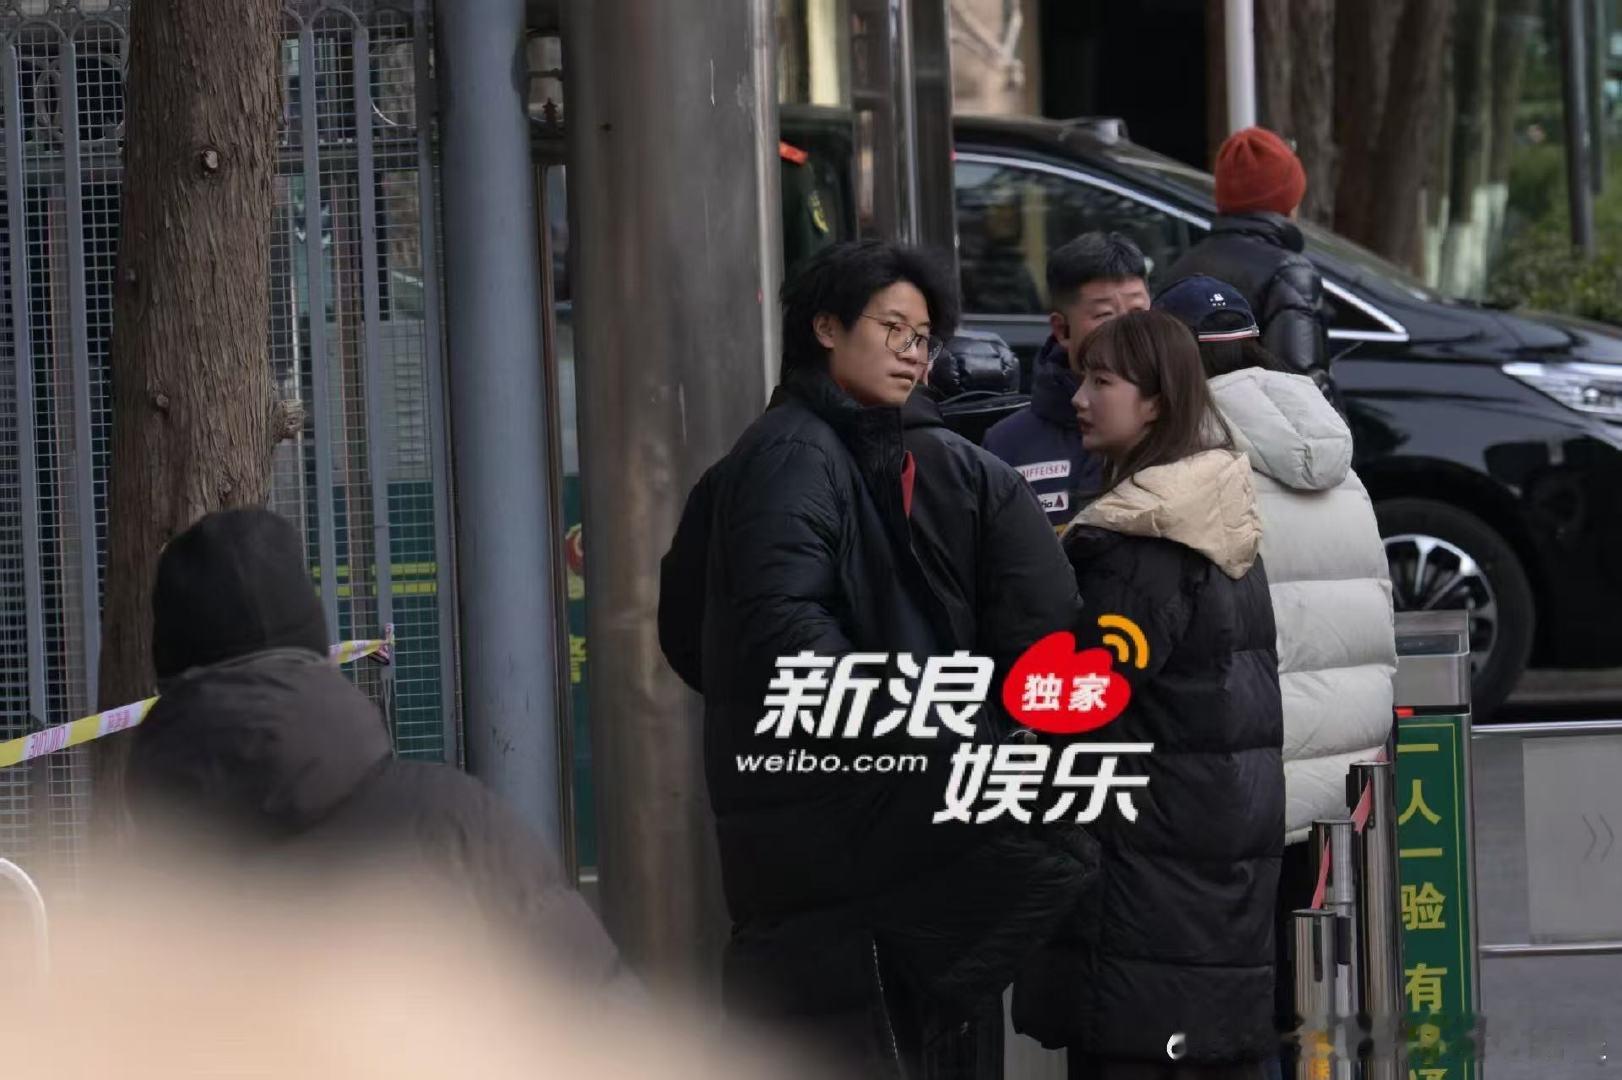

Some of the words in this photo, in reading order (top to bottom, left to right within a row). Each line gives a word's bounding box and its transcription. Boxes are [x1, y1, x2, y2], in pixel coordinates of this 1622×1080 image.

[1396, 743, 1449, 1080] 一人一验有
